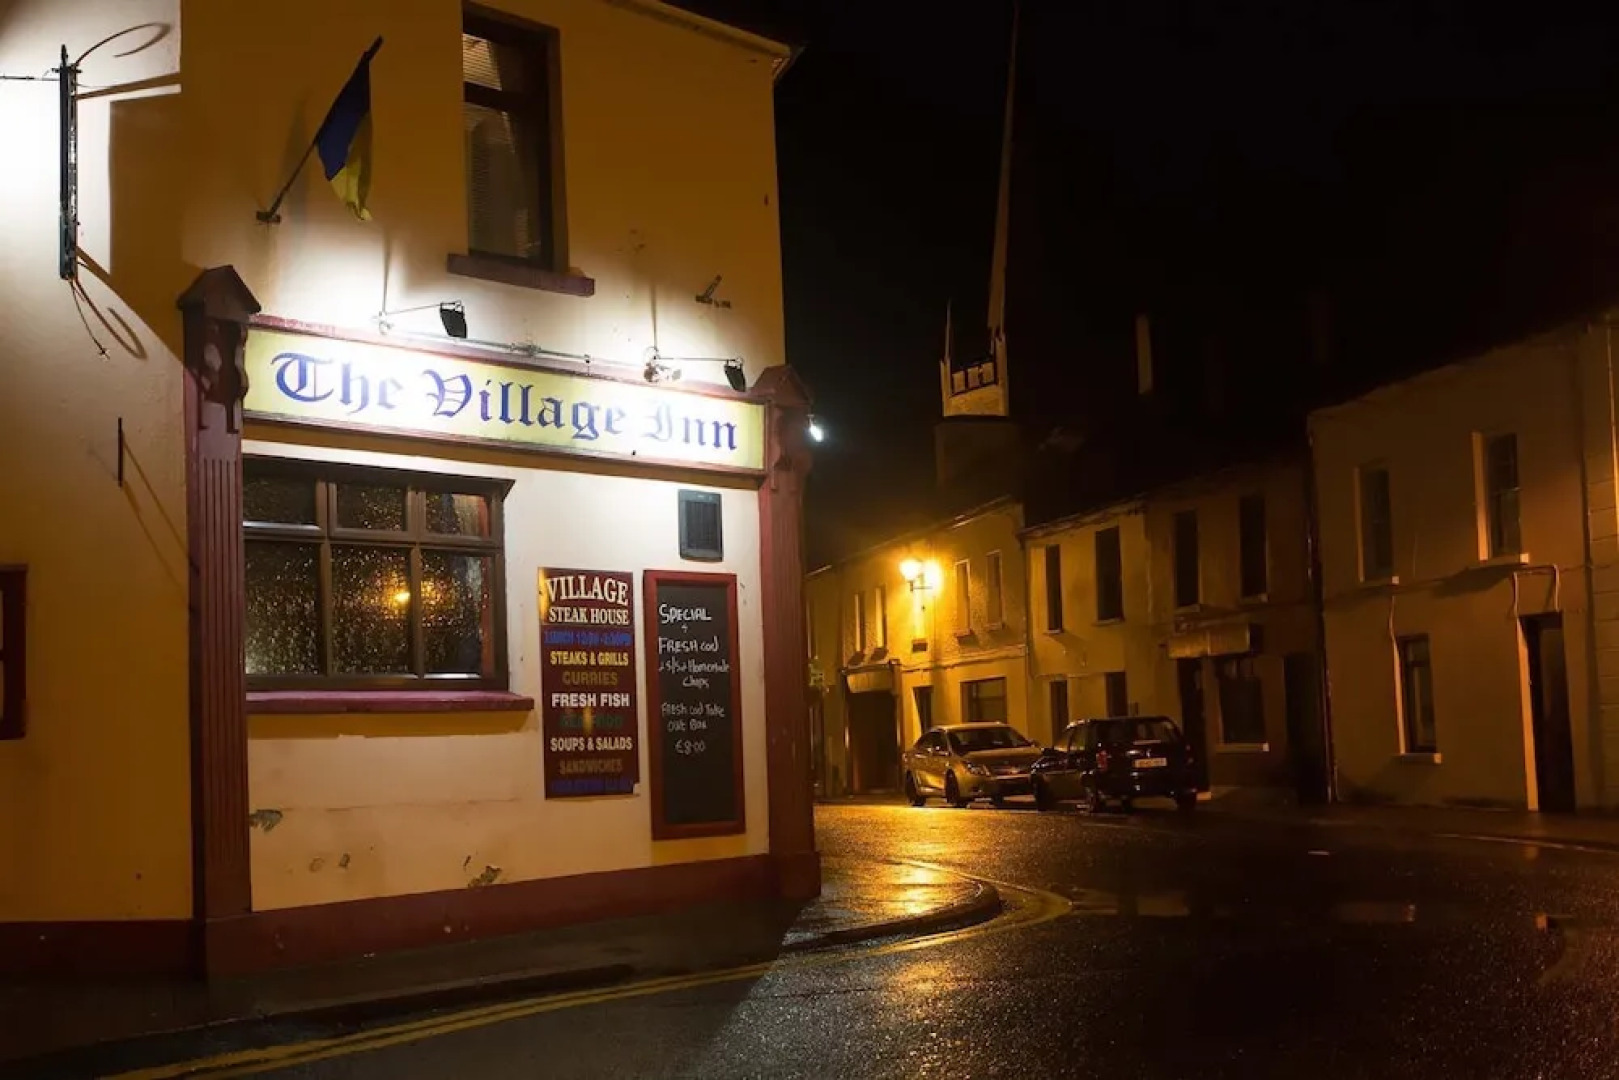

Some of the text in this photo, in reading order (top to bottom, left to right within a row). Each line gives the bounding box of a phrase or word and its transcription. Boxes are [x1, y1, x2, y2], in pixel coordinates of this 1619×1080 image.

[270, 352, 737, 450] The Village Inn
[546, 575, 629, 607] VILLAGE
[549, 606, 629, 626] STEAK HOUSE
[658, 603, 712, 624] SPECIAL
[658, 636, 699, 655] FRESH
[550, 650, 629, 666] STEAKS & GRILLS
[562, 671, 618, 686] CURRIES
[551, 692, 631, 707] FRESH FISH
[550, 736, 633, 752] SOUPS & SALADS
